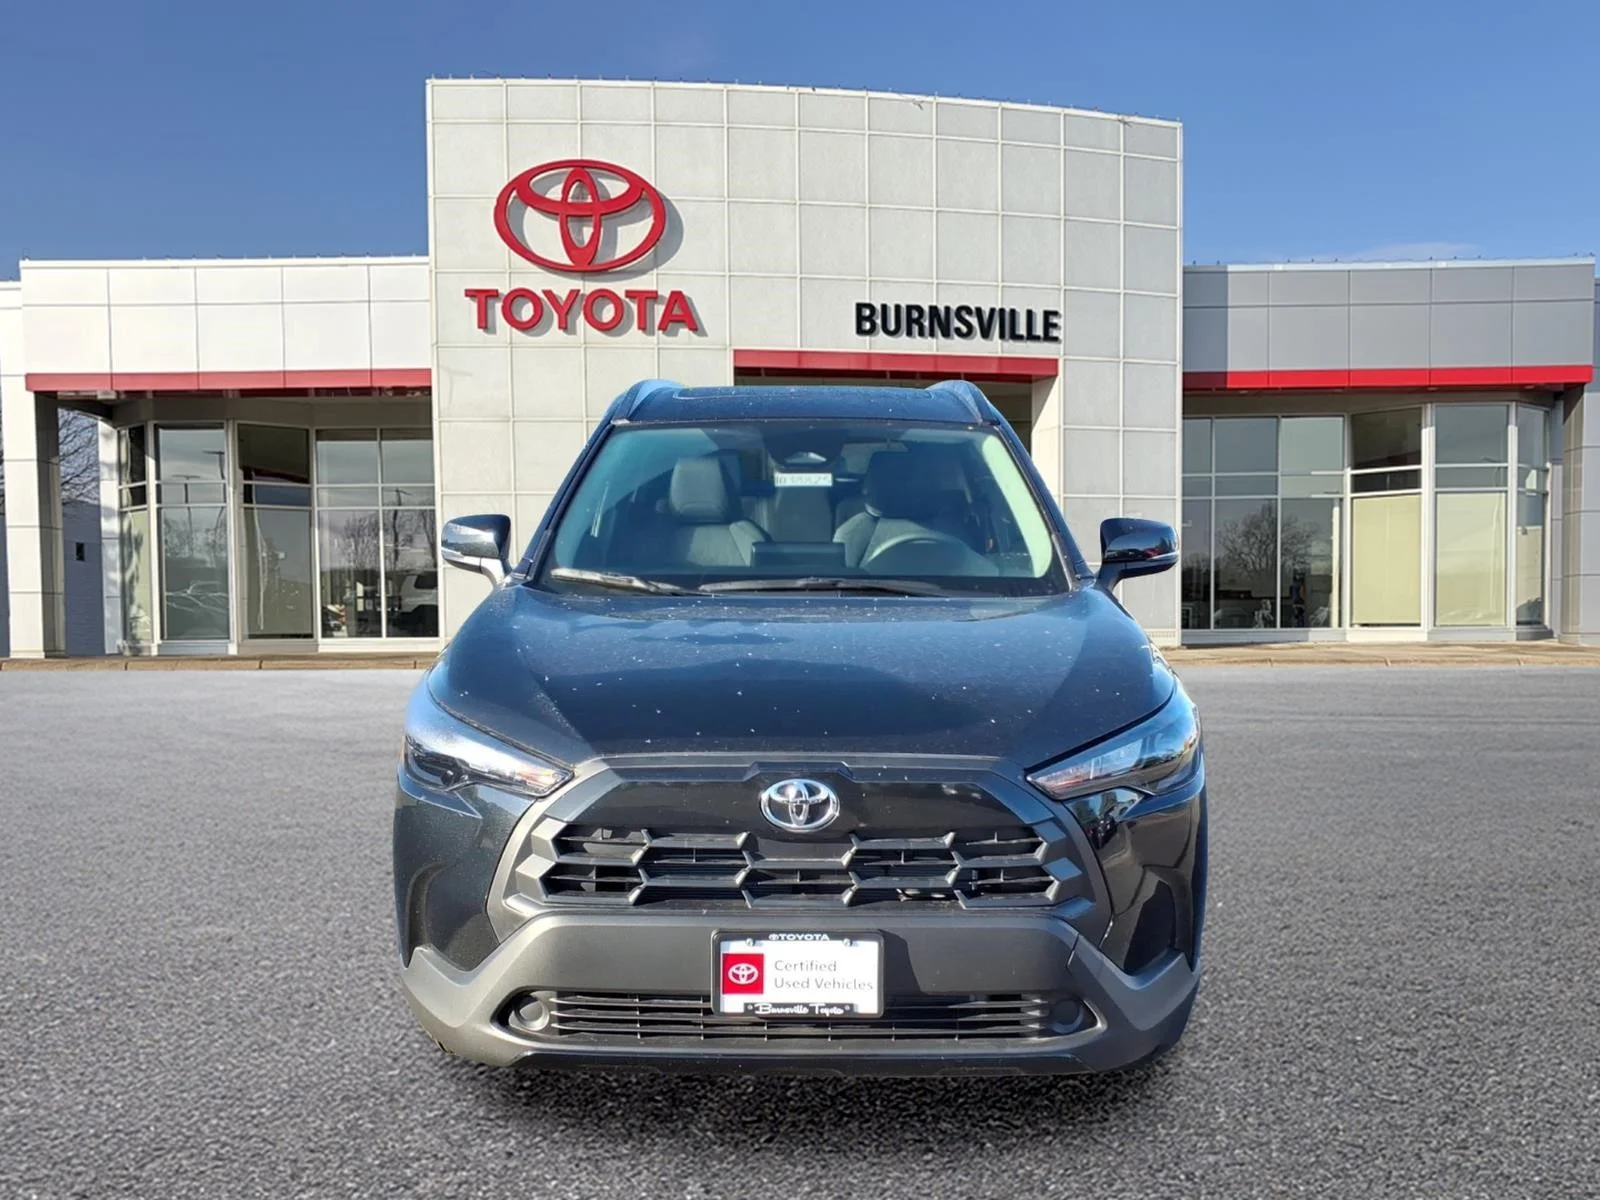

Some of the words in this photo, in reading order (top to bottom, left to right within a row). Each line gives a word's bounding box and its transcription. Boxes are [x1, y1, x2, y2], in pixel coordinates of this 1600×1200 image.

[464, 287, 698, 331] TOYOTA
[855, 302, 1060, 342] BURNSVILLE
[778, 933, 830, 941] TOYOTA
[774, 960, 837, 972] Certified
[774, 978, 810, 989] Used
[814, 978, 874, 990] Vehicles
